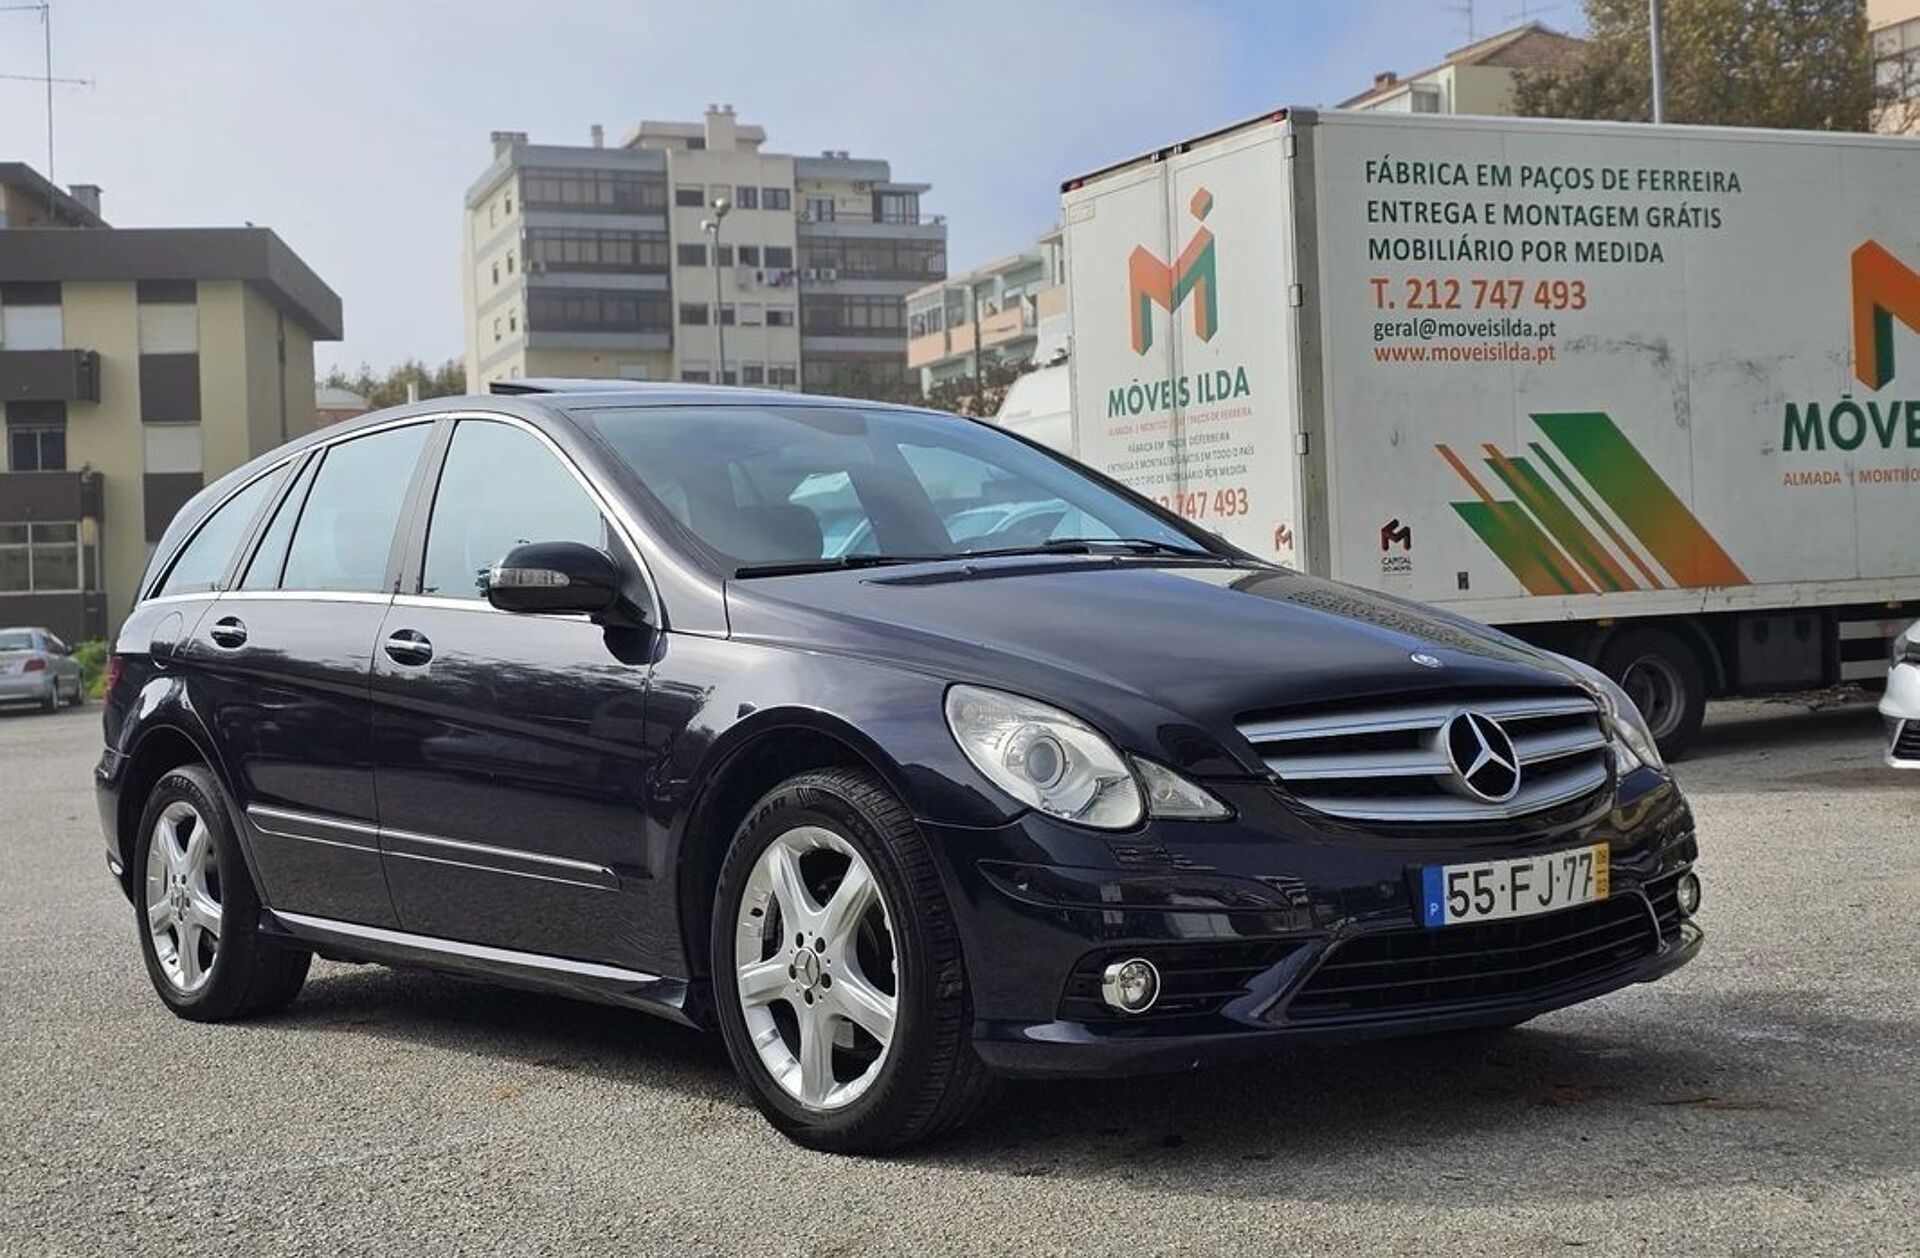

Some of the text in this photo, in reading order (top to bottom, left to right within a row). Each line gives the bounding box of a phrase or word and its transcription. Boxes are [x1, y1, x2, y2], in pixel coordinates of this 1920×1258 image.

[1366, 154, 1742, 195] FÁBRICA EM PAÇOS DE FERREIRA
[1368, 200, 1722, 229] ENTREGA E MONTAGEM GRÁTIS
[1369, 233, 1665, 264] MOBILIÁRIO POR MEDIDA
[1371, 278, 1587, 310] T. 212 747 493
[1374, 318, 1557, 342] geral@moveisilda.pt
[1374, 341, 1557, 365] www.moveisilda.pt
[1107, 366, 1250, 418] MÓVEIS ILDA
[1784, 471, 1842, 486] ALMADA
[1176, 491, 1208, 519] 747
[1214, 488, 1249, 516] 493
